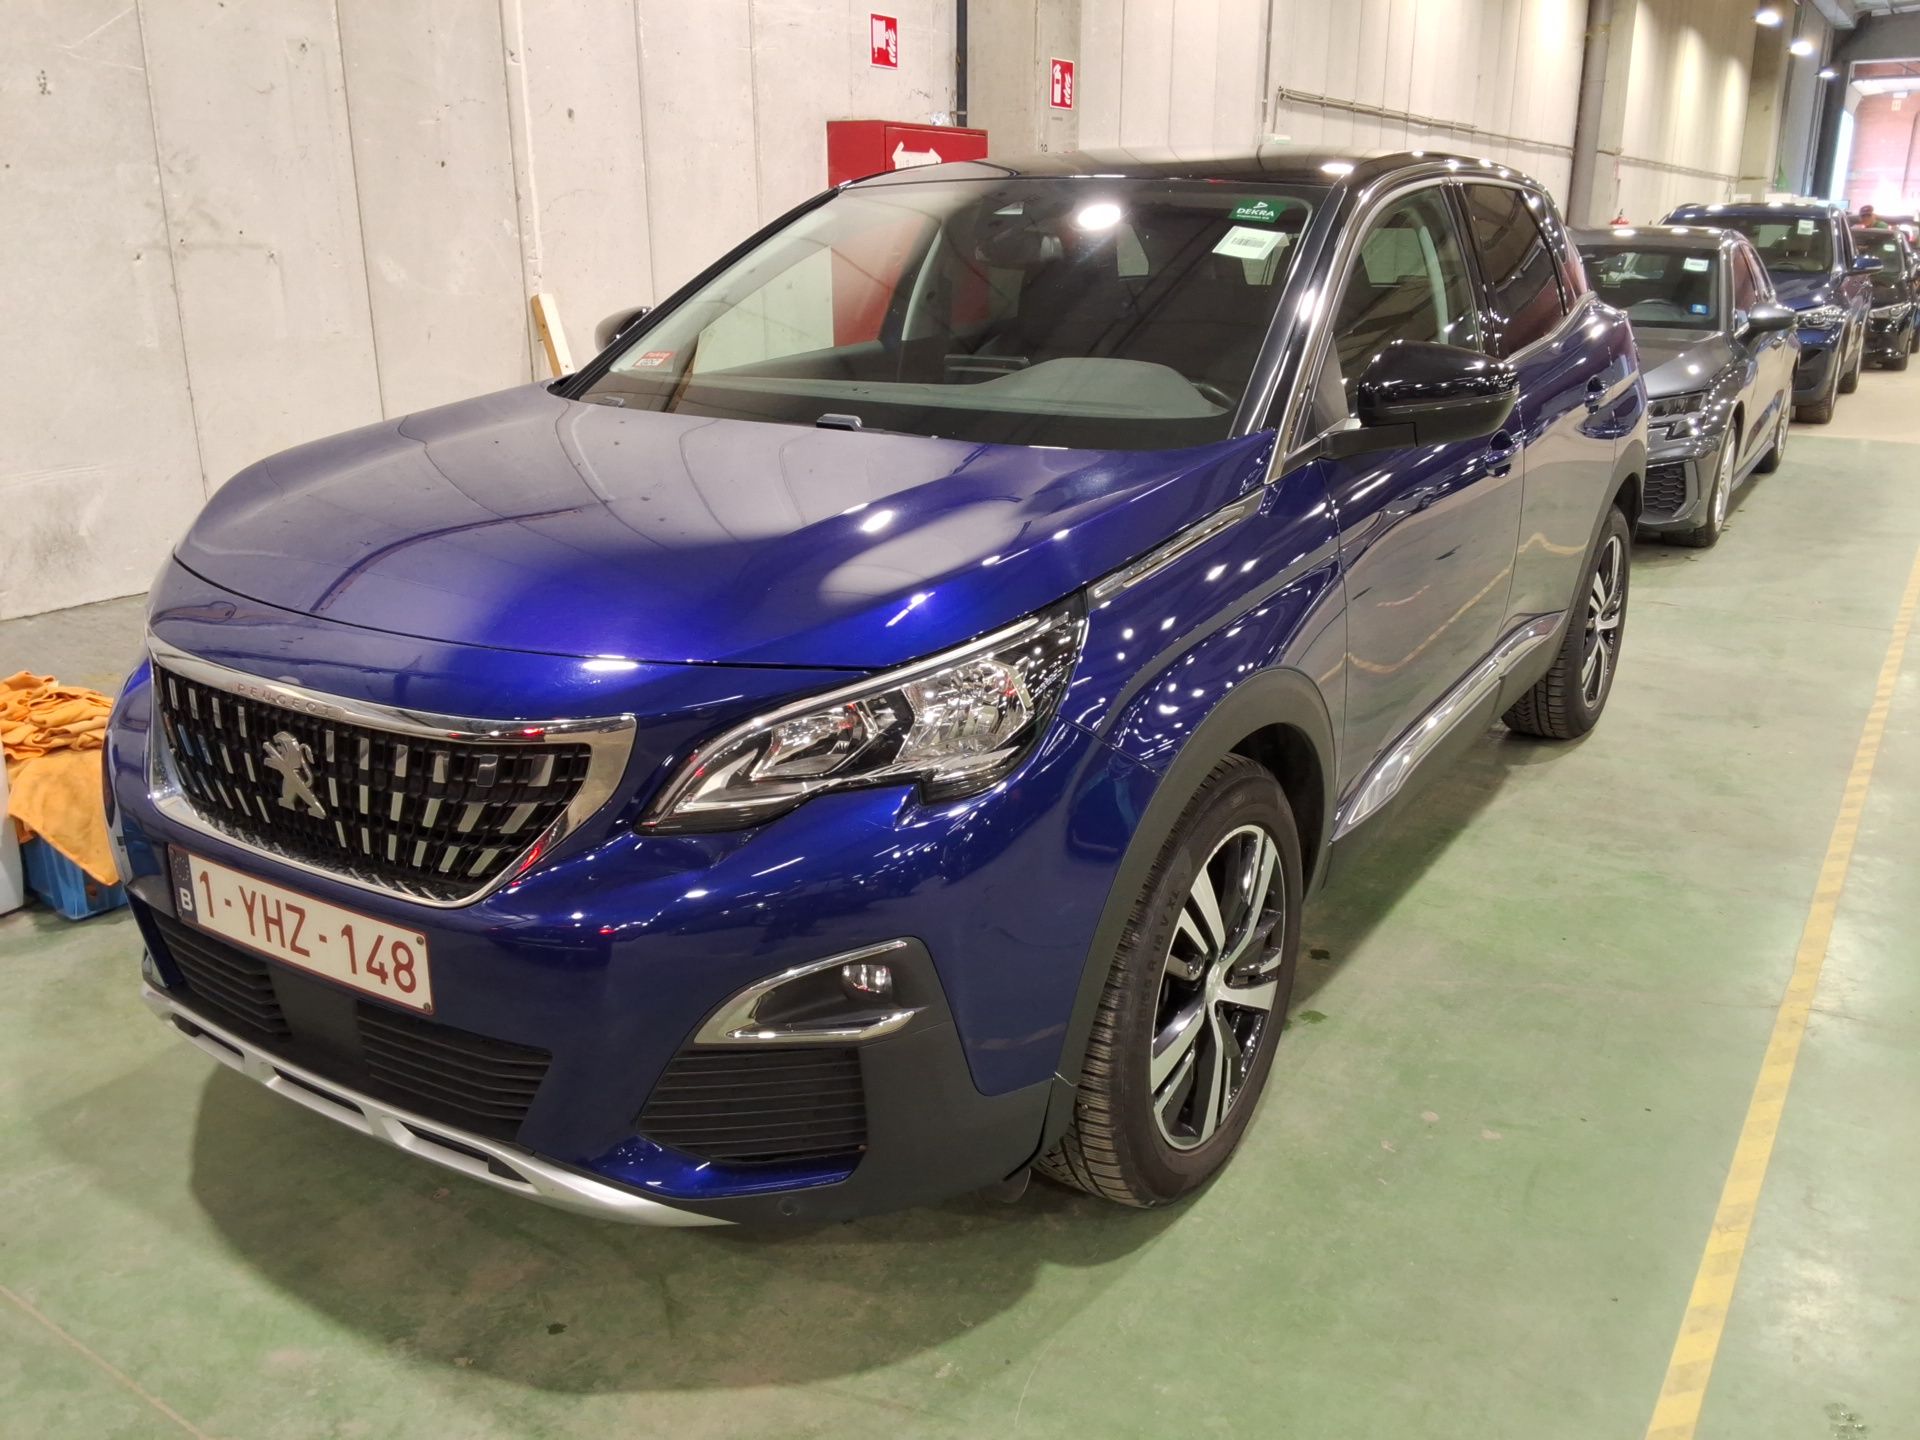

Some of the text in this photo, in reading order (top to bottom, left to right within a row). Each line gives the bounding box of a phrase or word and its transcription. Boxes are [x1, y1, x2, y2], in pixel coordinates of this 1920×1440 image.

[1236, 207, 1274, 217] DEKRA
[237, 683, 333, 715] PEUGEOT
[179, 887, 194, 912] B
[200, 870, 417, 994] 1-YHZ-148
